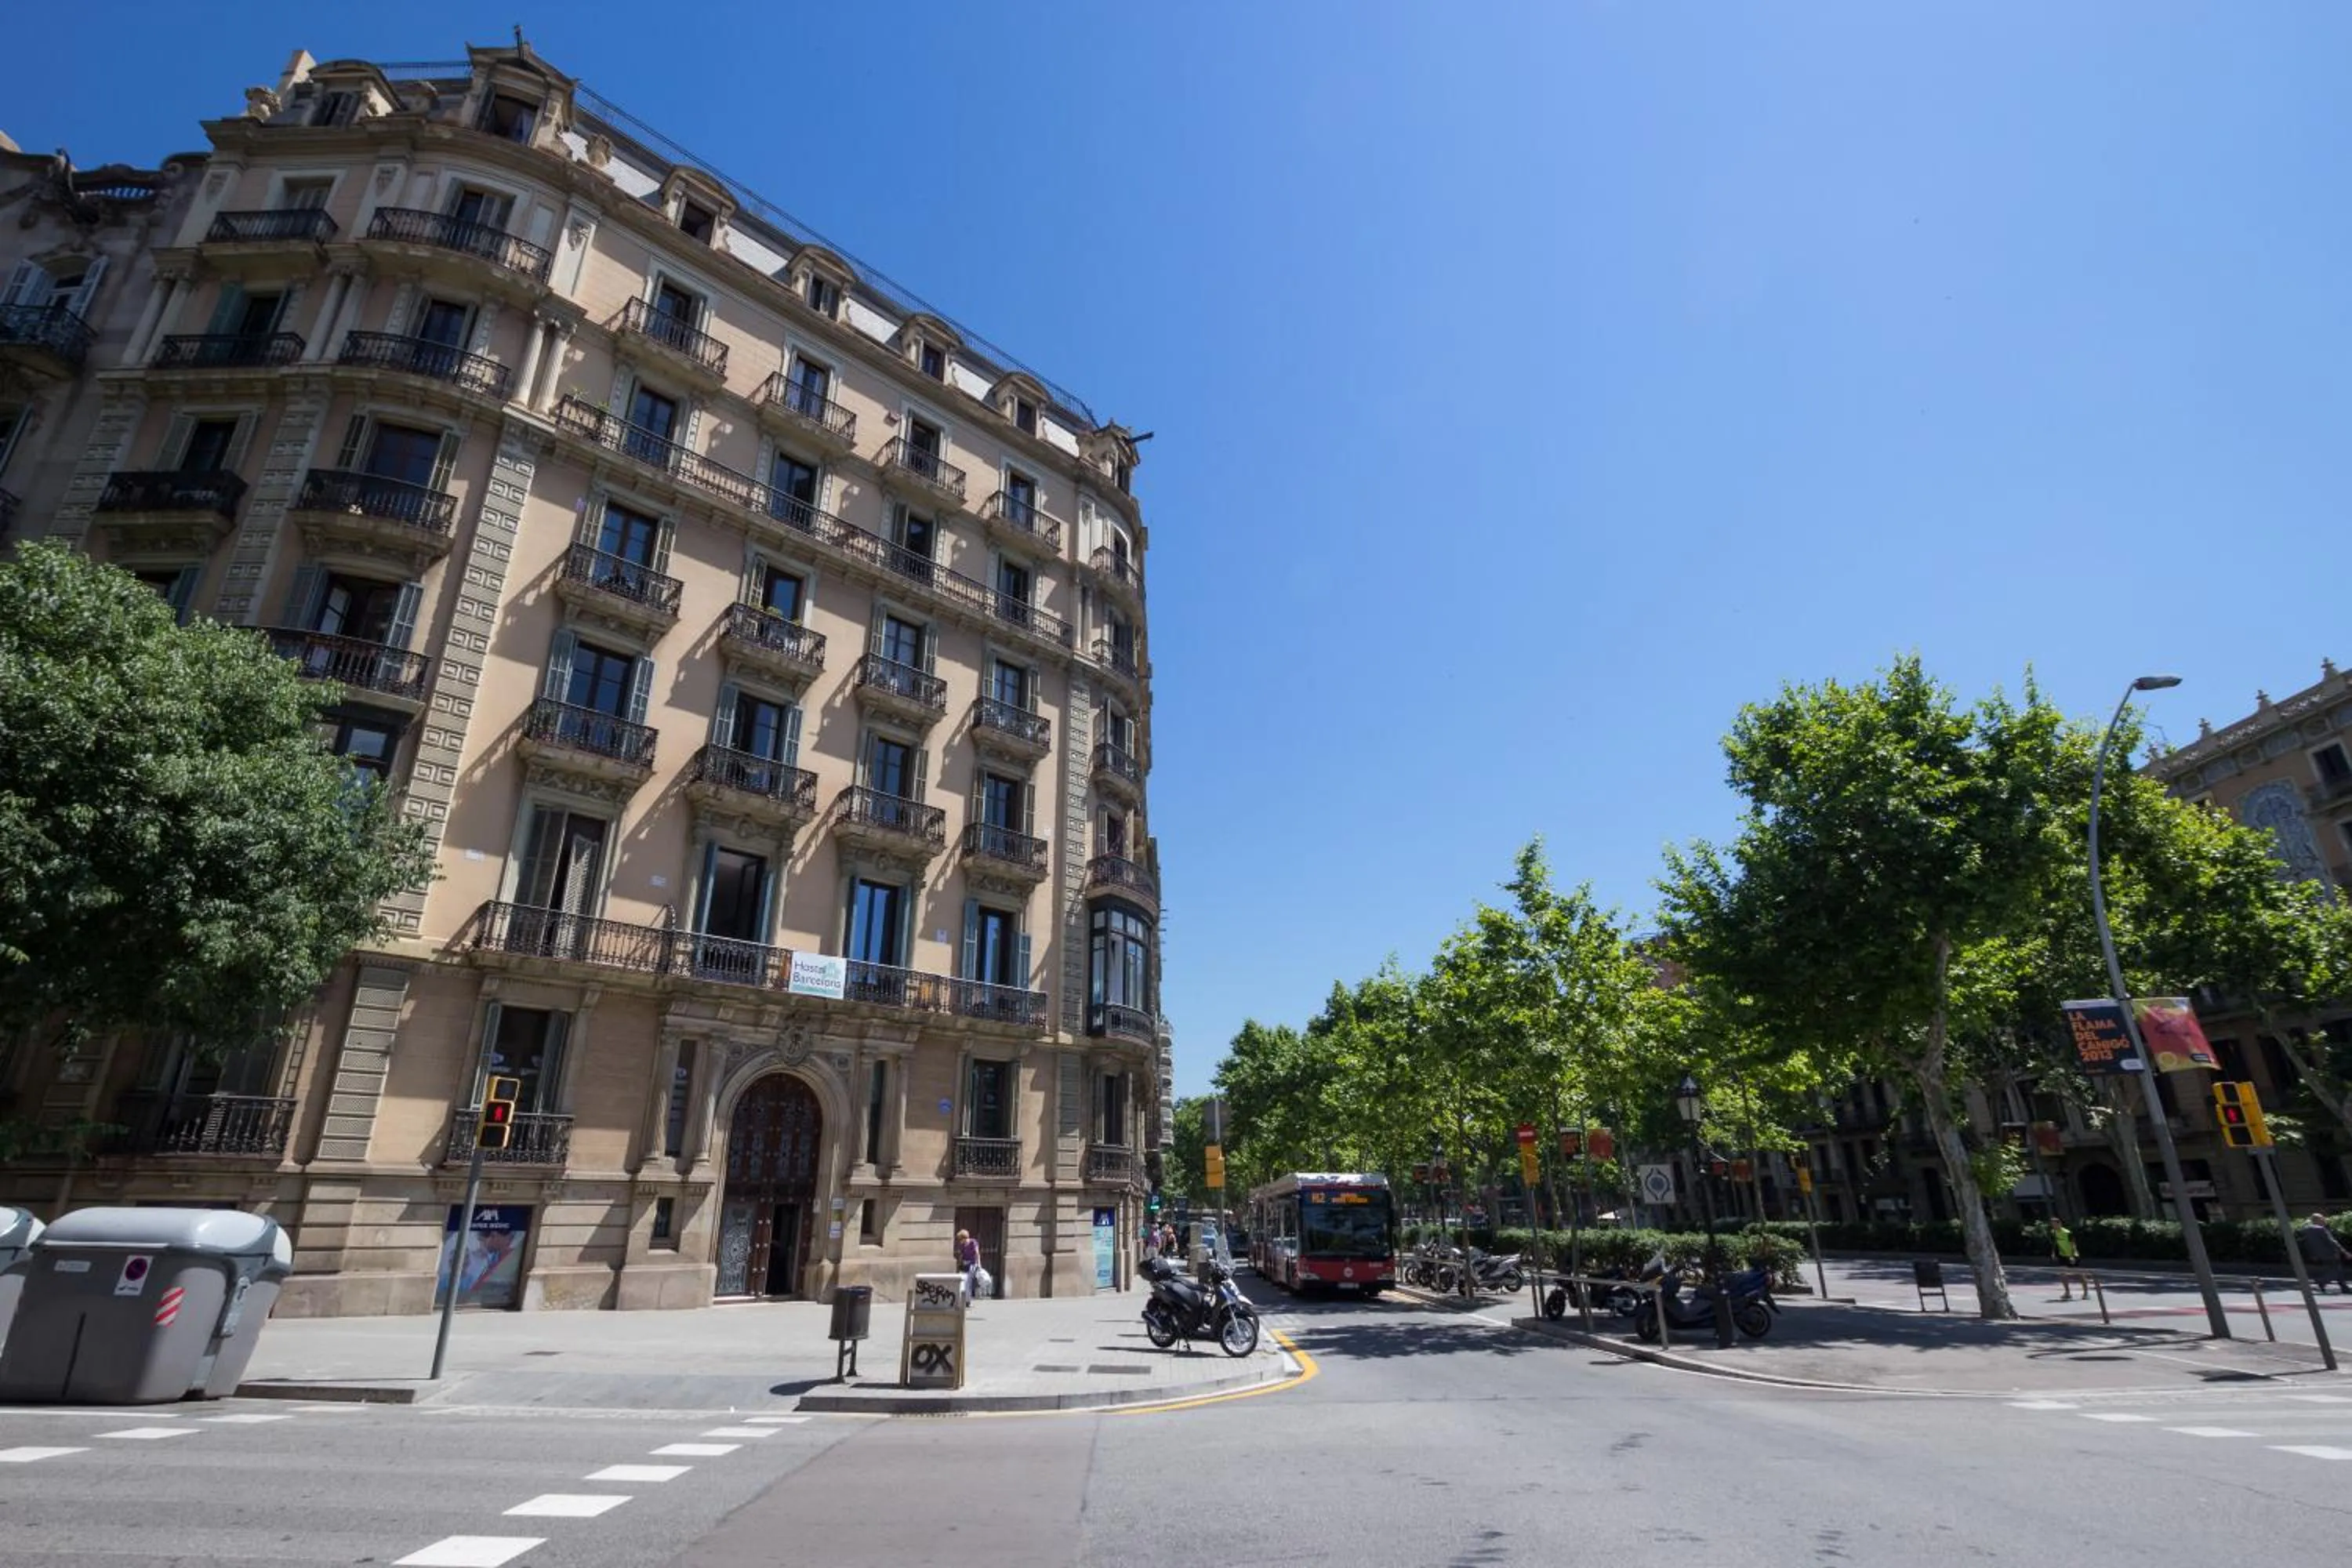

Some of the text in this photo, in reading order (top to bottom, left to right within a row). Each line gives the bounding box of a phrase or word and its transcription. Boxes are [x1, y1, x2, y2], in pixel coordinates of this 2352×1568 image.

[793, 971, 841, 988] Barcelona
[2067, 1011, 2086, 1021] LA
[2071, 1019, 2117, 1032] FLAMA
[2075, 1031, 2100, 1042] DEL
[474, 1208, 499, 1221] AXA
[911, 1342, 955, 1375] OX
